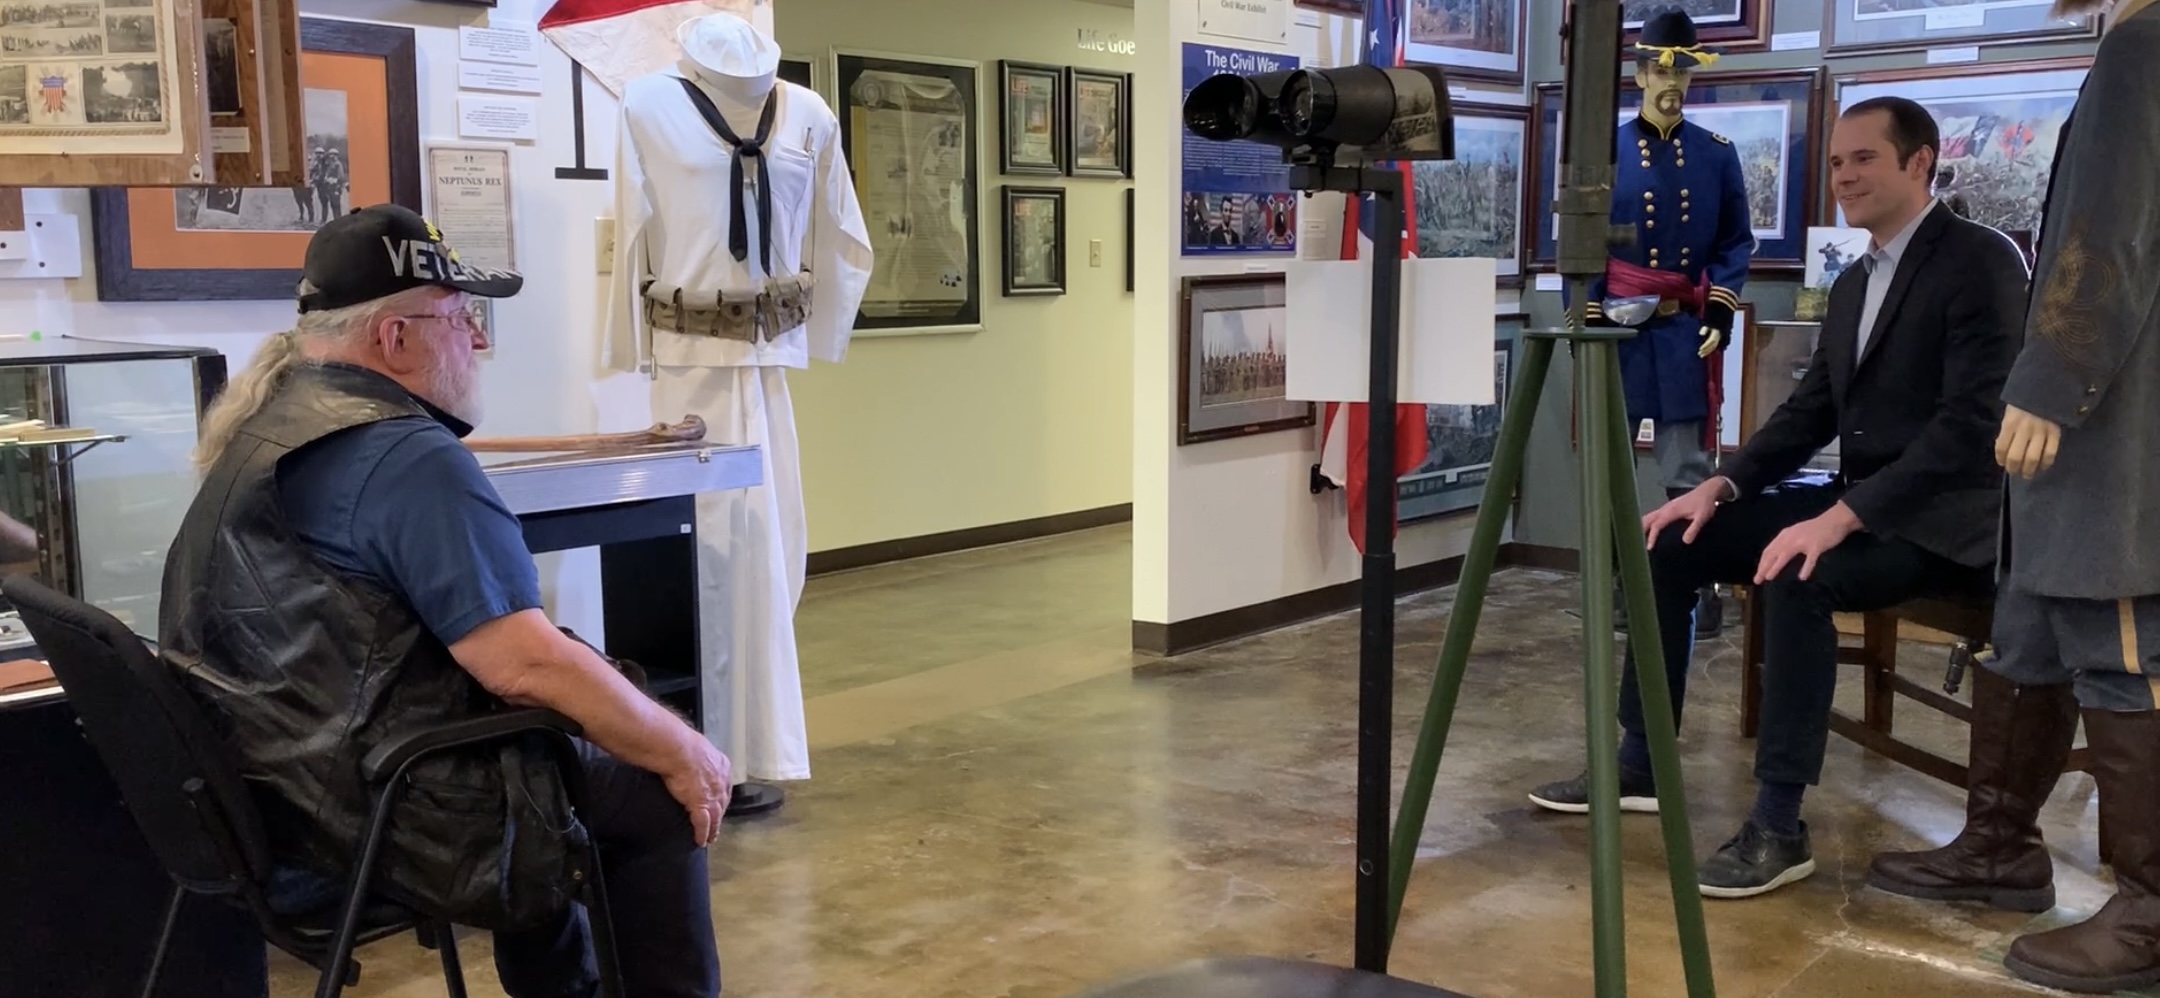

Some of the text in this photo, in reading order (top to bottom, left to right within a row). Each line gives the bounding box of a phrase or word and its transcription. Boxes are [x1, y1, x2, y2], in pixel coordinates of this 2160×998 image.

[1221, 0, 1267, 13] Civil War Exhibit
[1077, 28, 1105, 51] Life
[1205, 50, 1227, 68] The
[1230, 53, 1255, 71] Civil
[1257, 56, 1280, 73] War
[439, 176, 502, 186] NEPTUNUS REX
